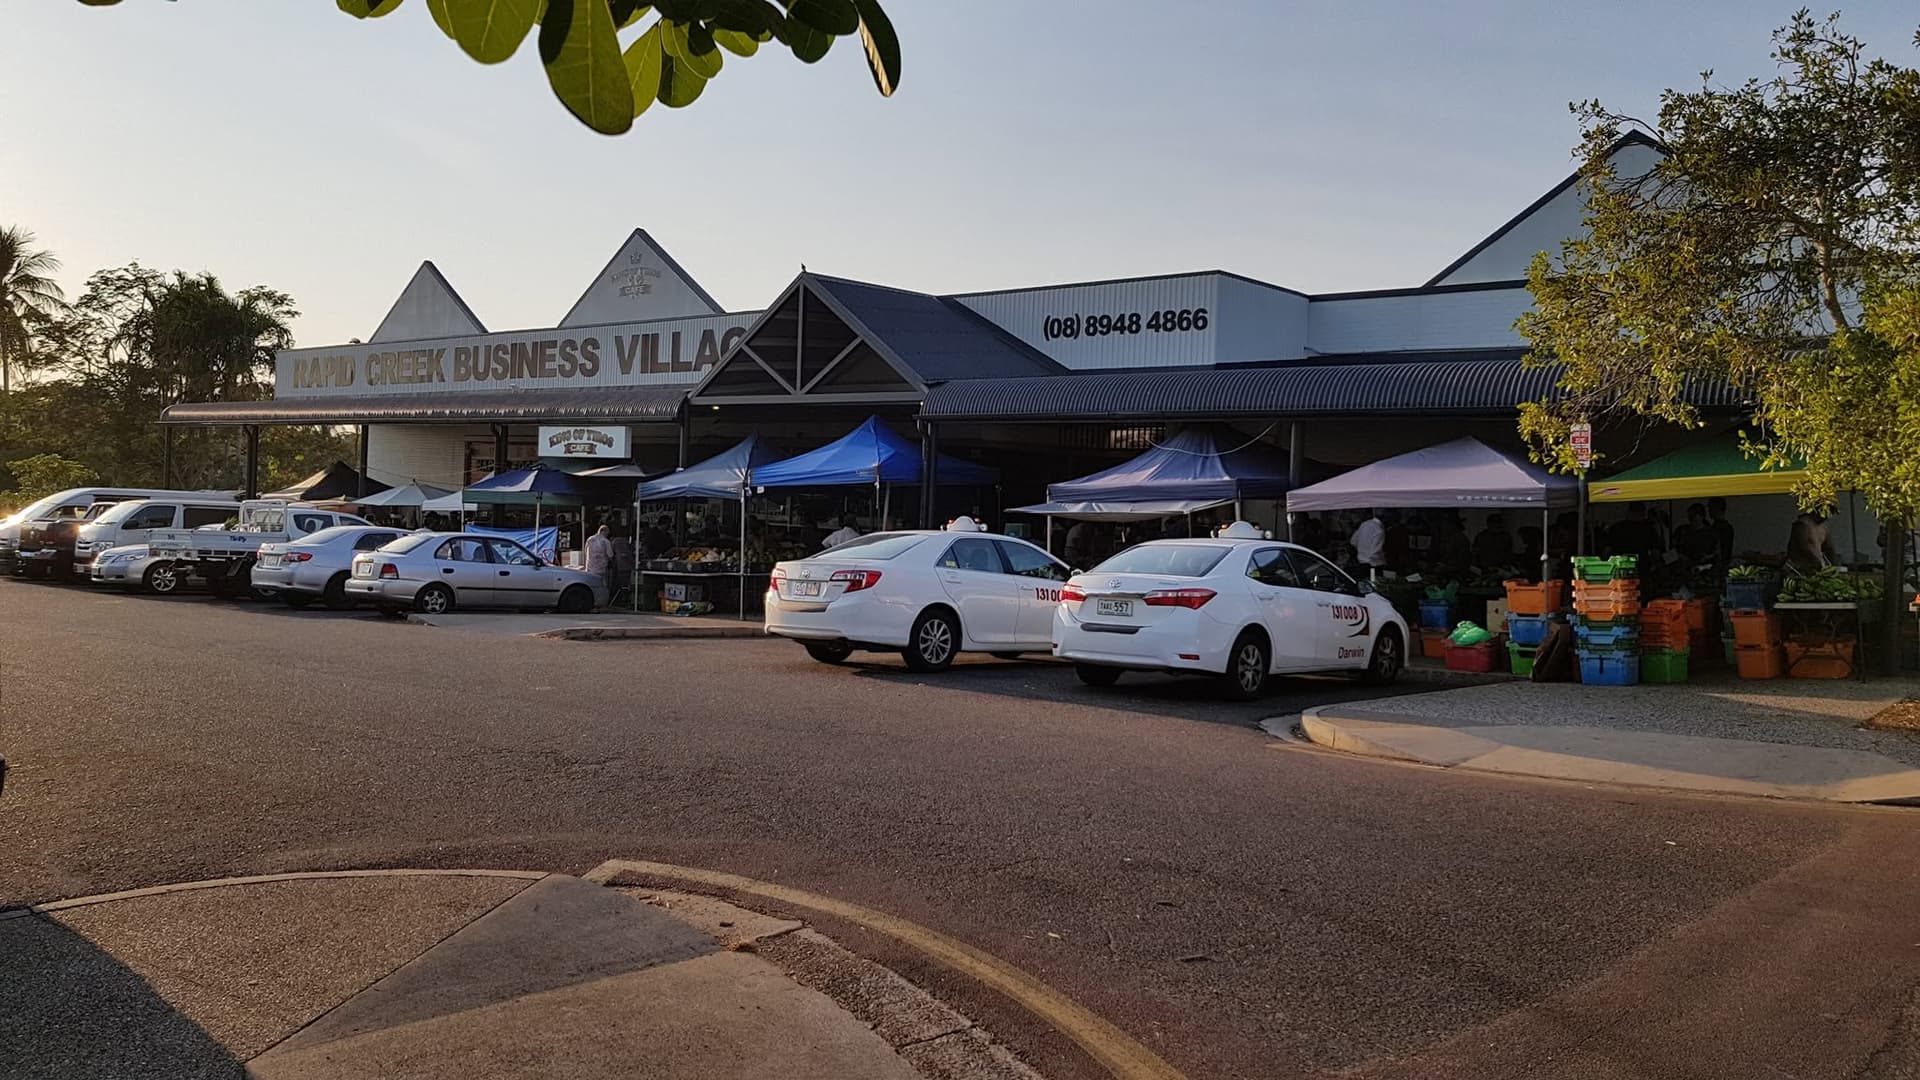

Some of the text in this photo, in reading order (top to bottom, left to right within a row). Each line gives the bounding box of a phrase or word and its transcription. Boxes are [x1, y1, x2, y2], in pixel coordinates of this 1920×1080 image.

[1043, 307, 1208, 341] (08) 8948 4866
[293, 355, 355, 389] RAPID
[365, 349, 446, 387] CREEK
[454, 336, 601, 382] BUSINESS
[548, 429, 572, 449] KING
[573, 428, 586, 441] OF
[569, 443, 592, 453] CAFE
[1113, 601, 1129, 613] 557
[1337, 645, 1365, 659] Darwin
